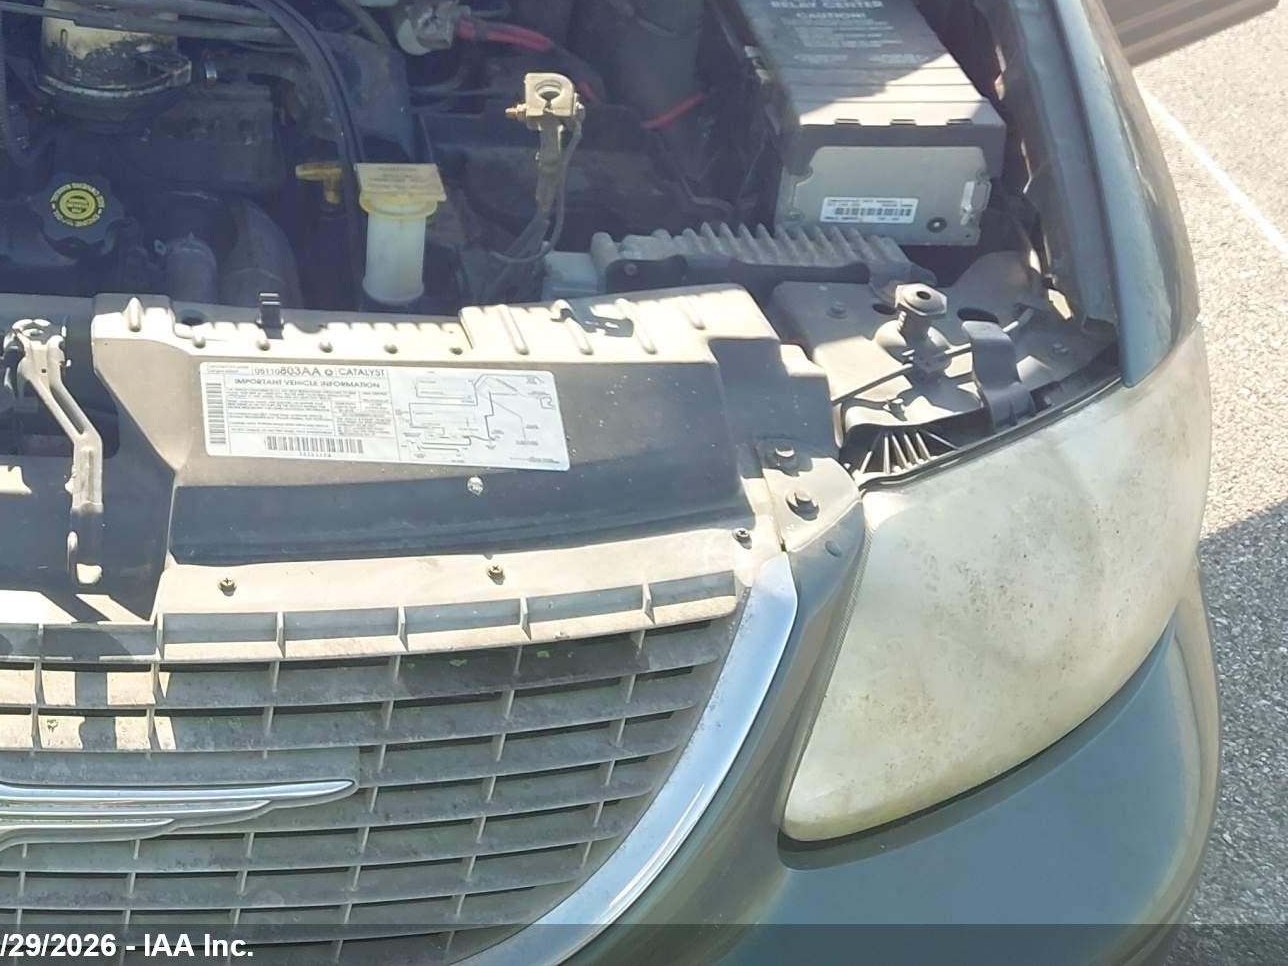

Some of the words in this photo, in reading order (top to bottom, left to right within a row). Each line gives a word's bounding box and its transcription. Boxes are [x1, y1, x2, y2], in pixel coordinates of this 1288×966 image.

[338, 368, 385, 377] CATALYST
[284, 379, 318, 387] VEHICLE
[320, 380, 380, 388] INFORMATION
